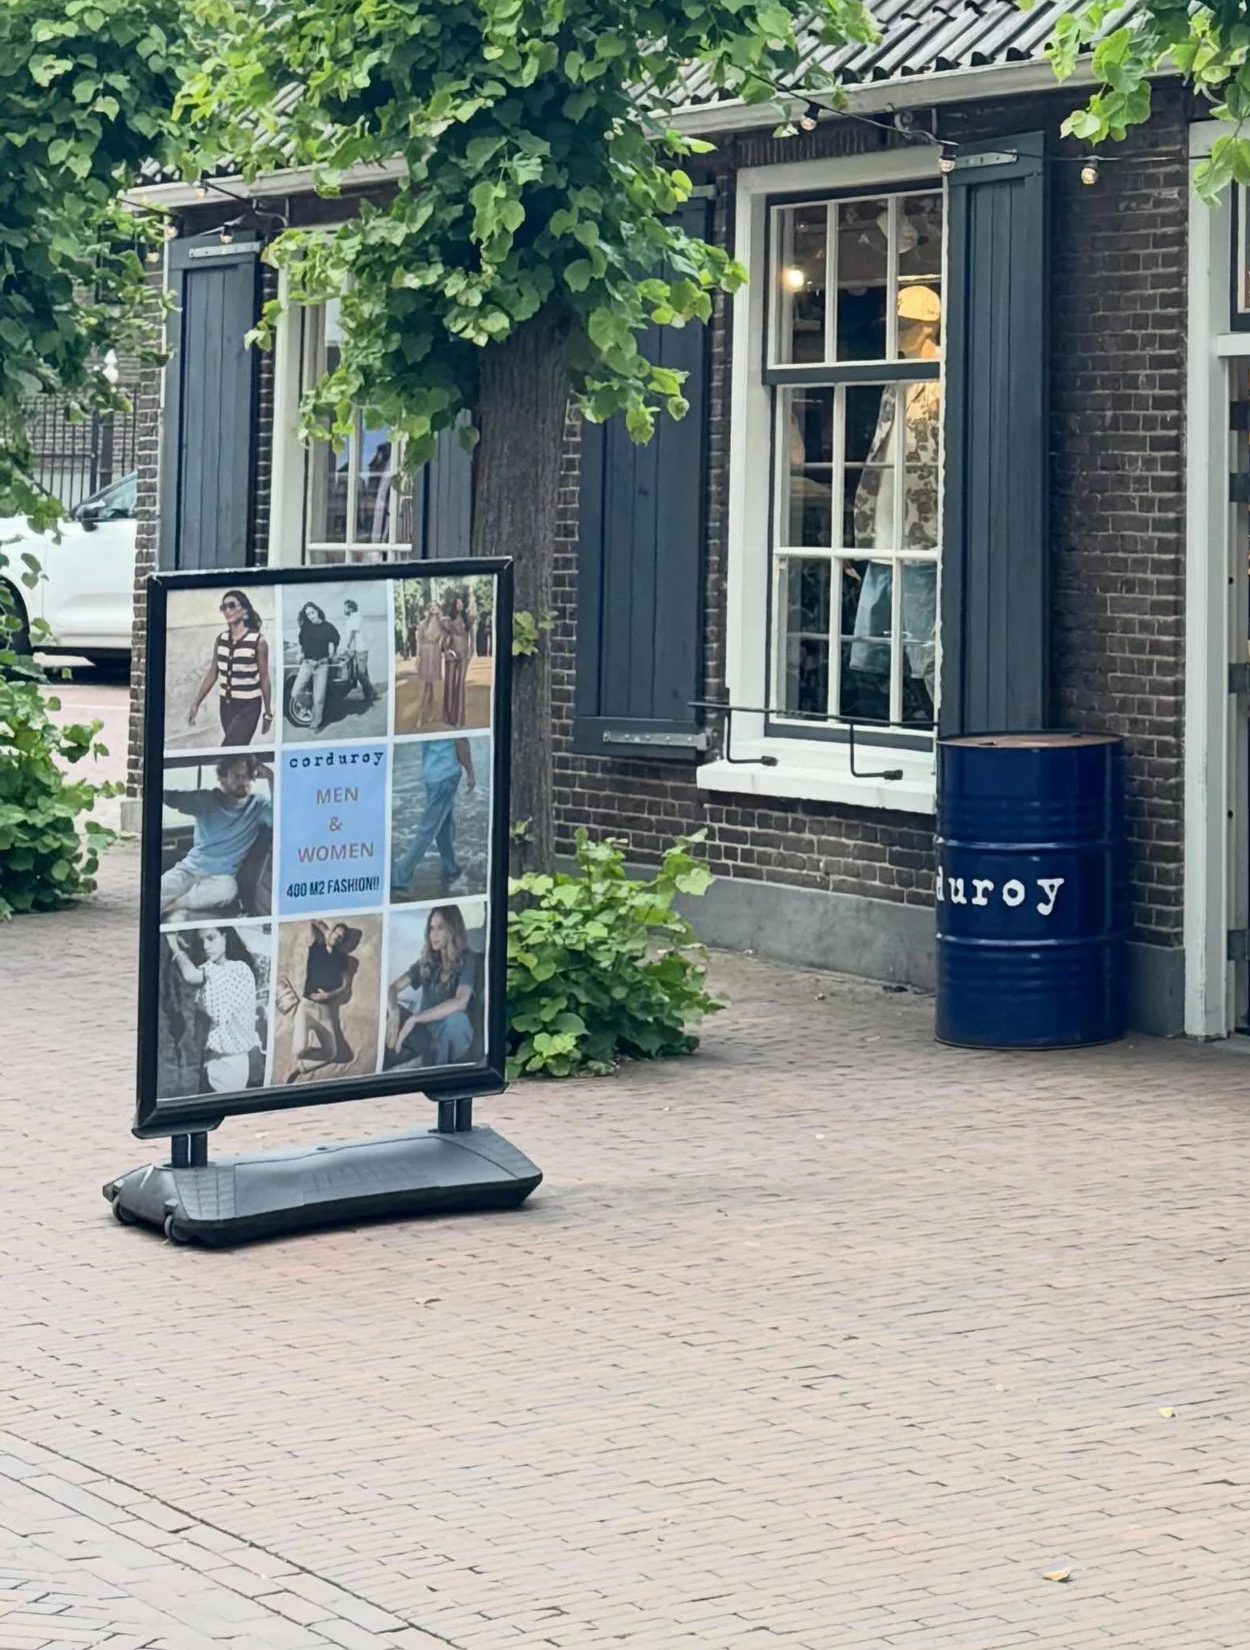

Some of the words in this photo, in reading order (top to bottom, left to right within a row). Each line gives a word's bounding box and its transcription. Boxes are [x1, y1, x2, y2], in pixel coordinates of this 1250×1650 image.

[289, 751, 384, 768] corduroy
[316, 787, 359, 804] MEN
[328, 816, 343, 832] &
[298, 842, 374, 863] WOMEN
[286, 881, 308, 898] 400
[309, 878, 325, 896] M2
